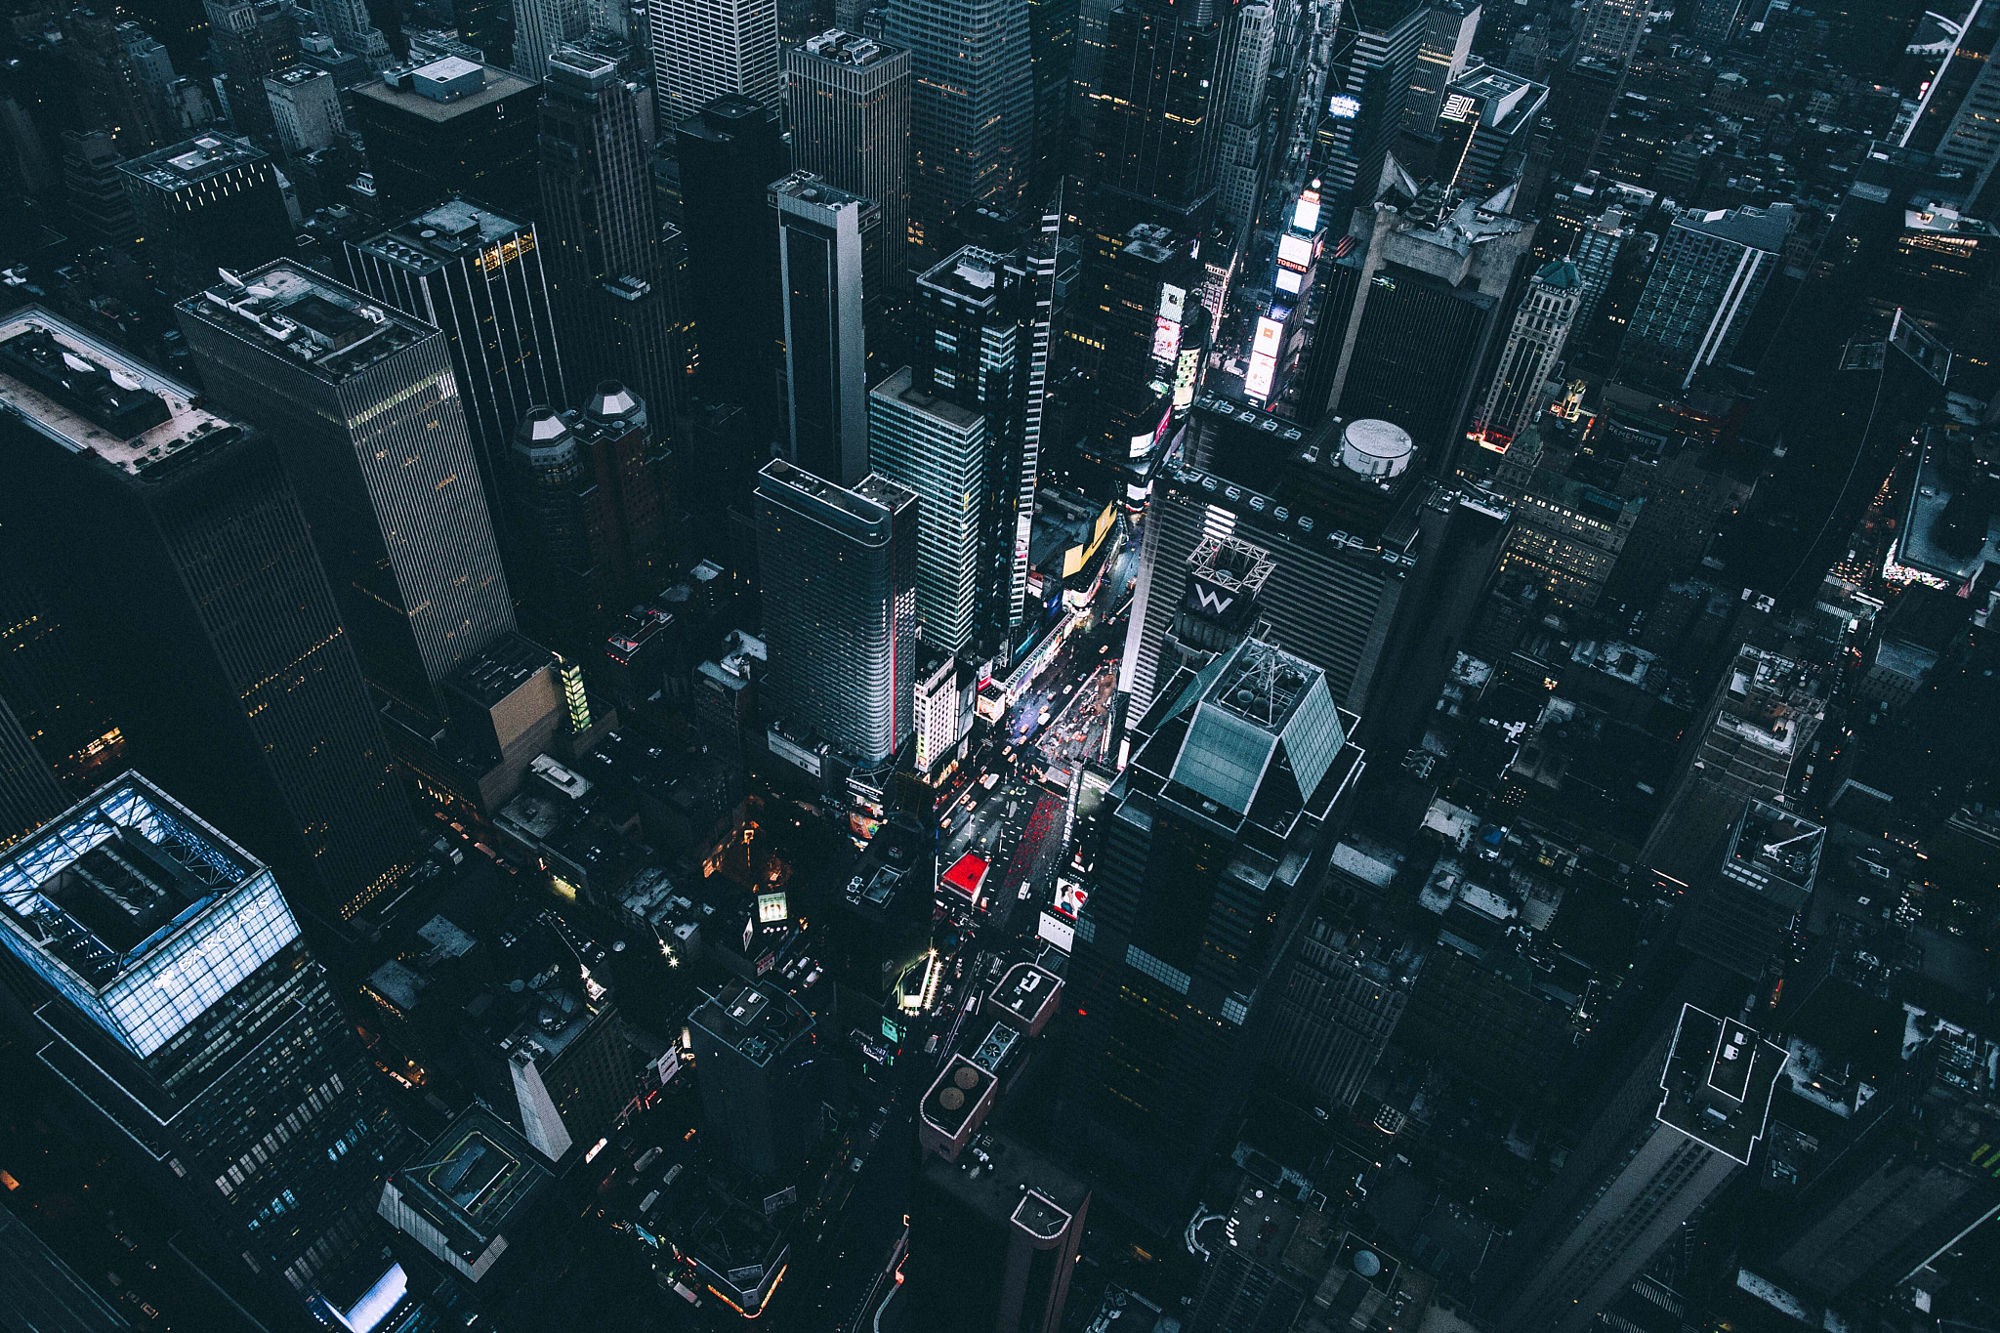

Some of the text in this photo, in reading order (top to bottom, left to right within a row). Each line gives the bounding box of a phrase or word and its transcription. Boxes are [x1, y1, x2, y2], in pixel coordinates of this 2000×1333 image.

[1277, 258, 1307, 273] TOSHIBA
[1608, 424, 1657, 446] REMEMBER
[1195, 583, 1234, 614] W
[178, 895, 269, 968] BARCLAYS
